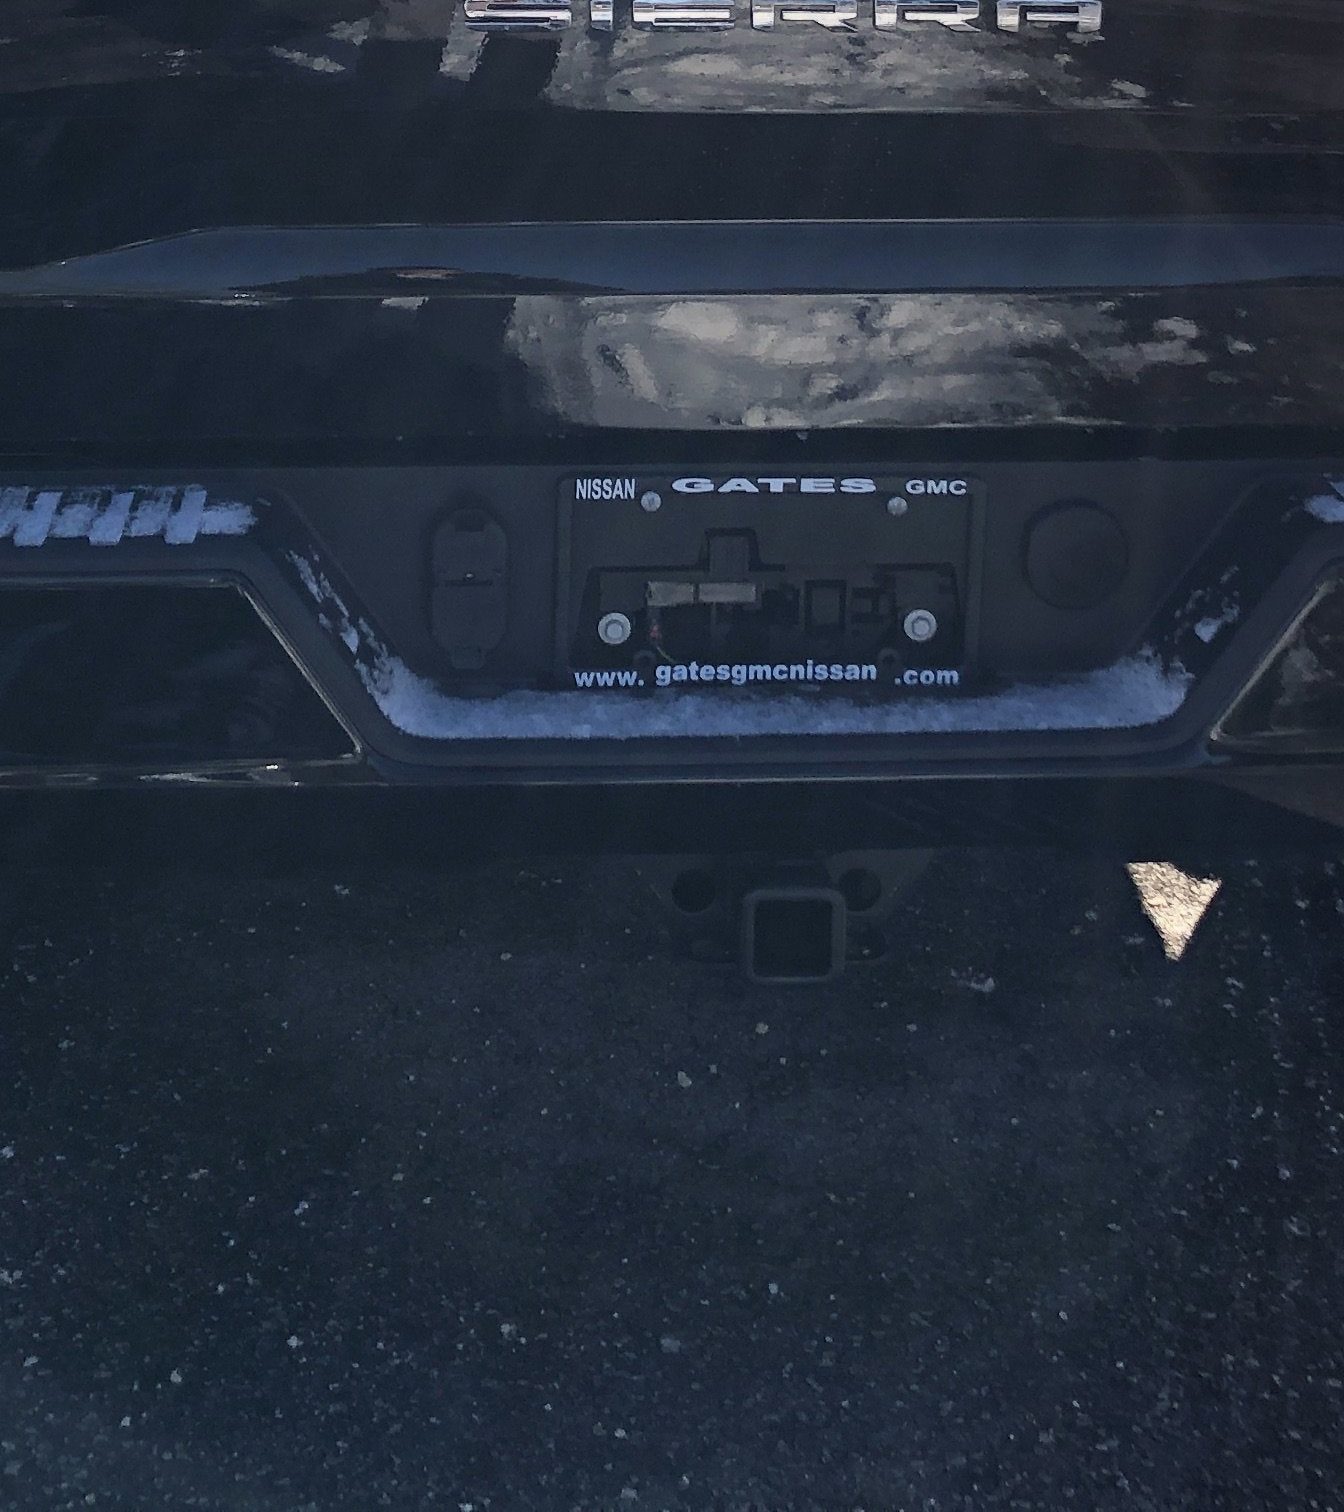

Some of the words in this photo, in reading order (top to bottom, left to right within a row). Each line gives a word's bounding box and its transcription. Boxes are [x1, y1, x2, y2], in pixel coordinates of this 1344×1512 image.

[574, 478, 636, 501] NISSAN
[671, 477, 877, 494] GATES
[905, 479, 968, 496] GMC
[574, 669, 645, 687] www.
[655, 659, 877, 686] gatesgmcnissan
[894, 667, 960, 686] .com
